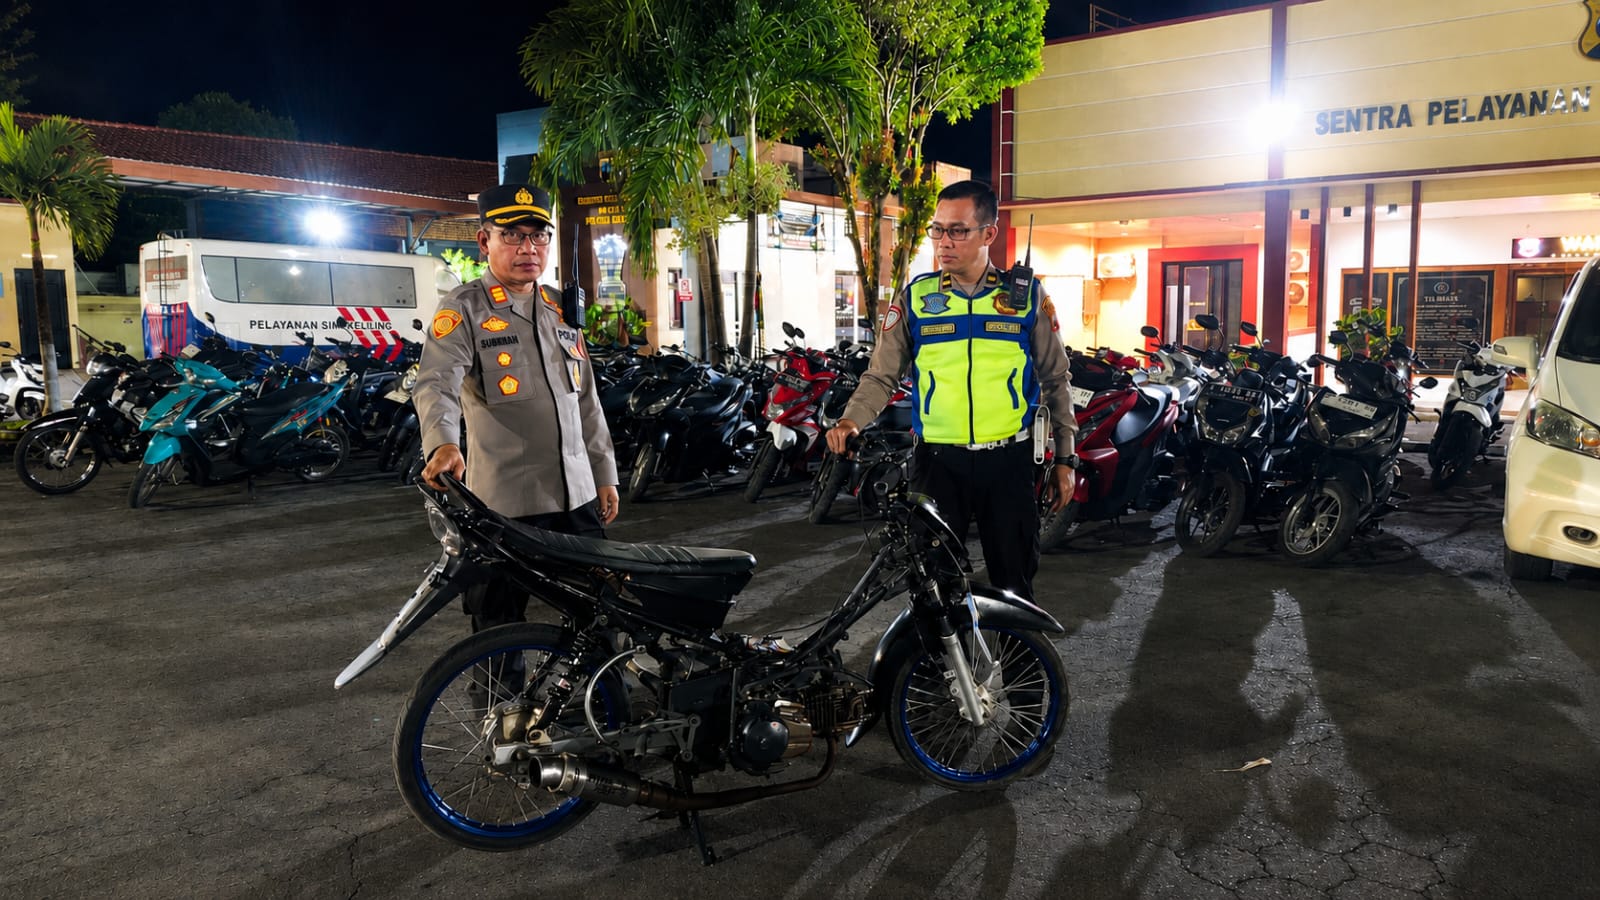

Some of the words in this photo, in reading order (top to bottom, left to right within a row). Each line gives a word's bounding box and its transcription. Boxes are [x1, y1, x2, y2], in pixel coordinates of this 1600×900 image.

[1315, 103, 1413, 136] SENTRA
[1427, 86, 1592, 126] PELAYANAN
[249, 319, 318, 330] PELAYANAN
